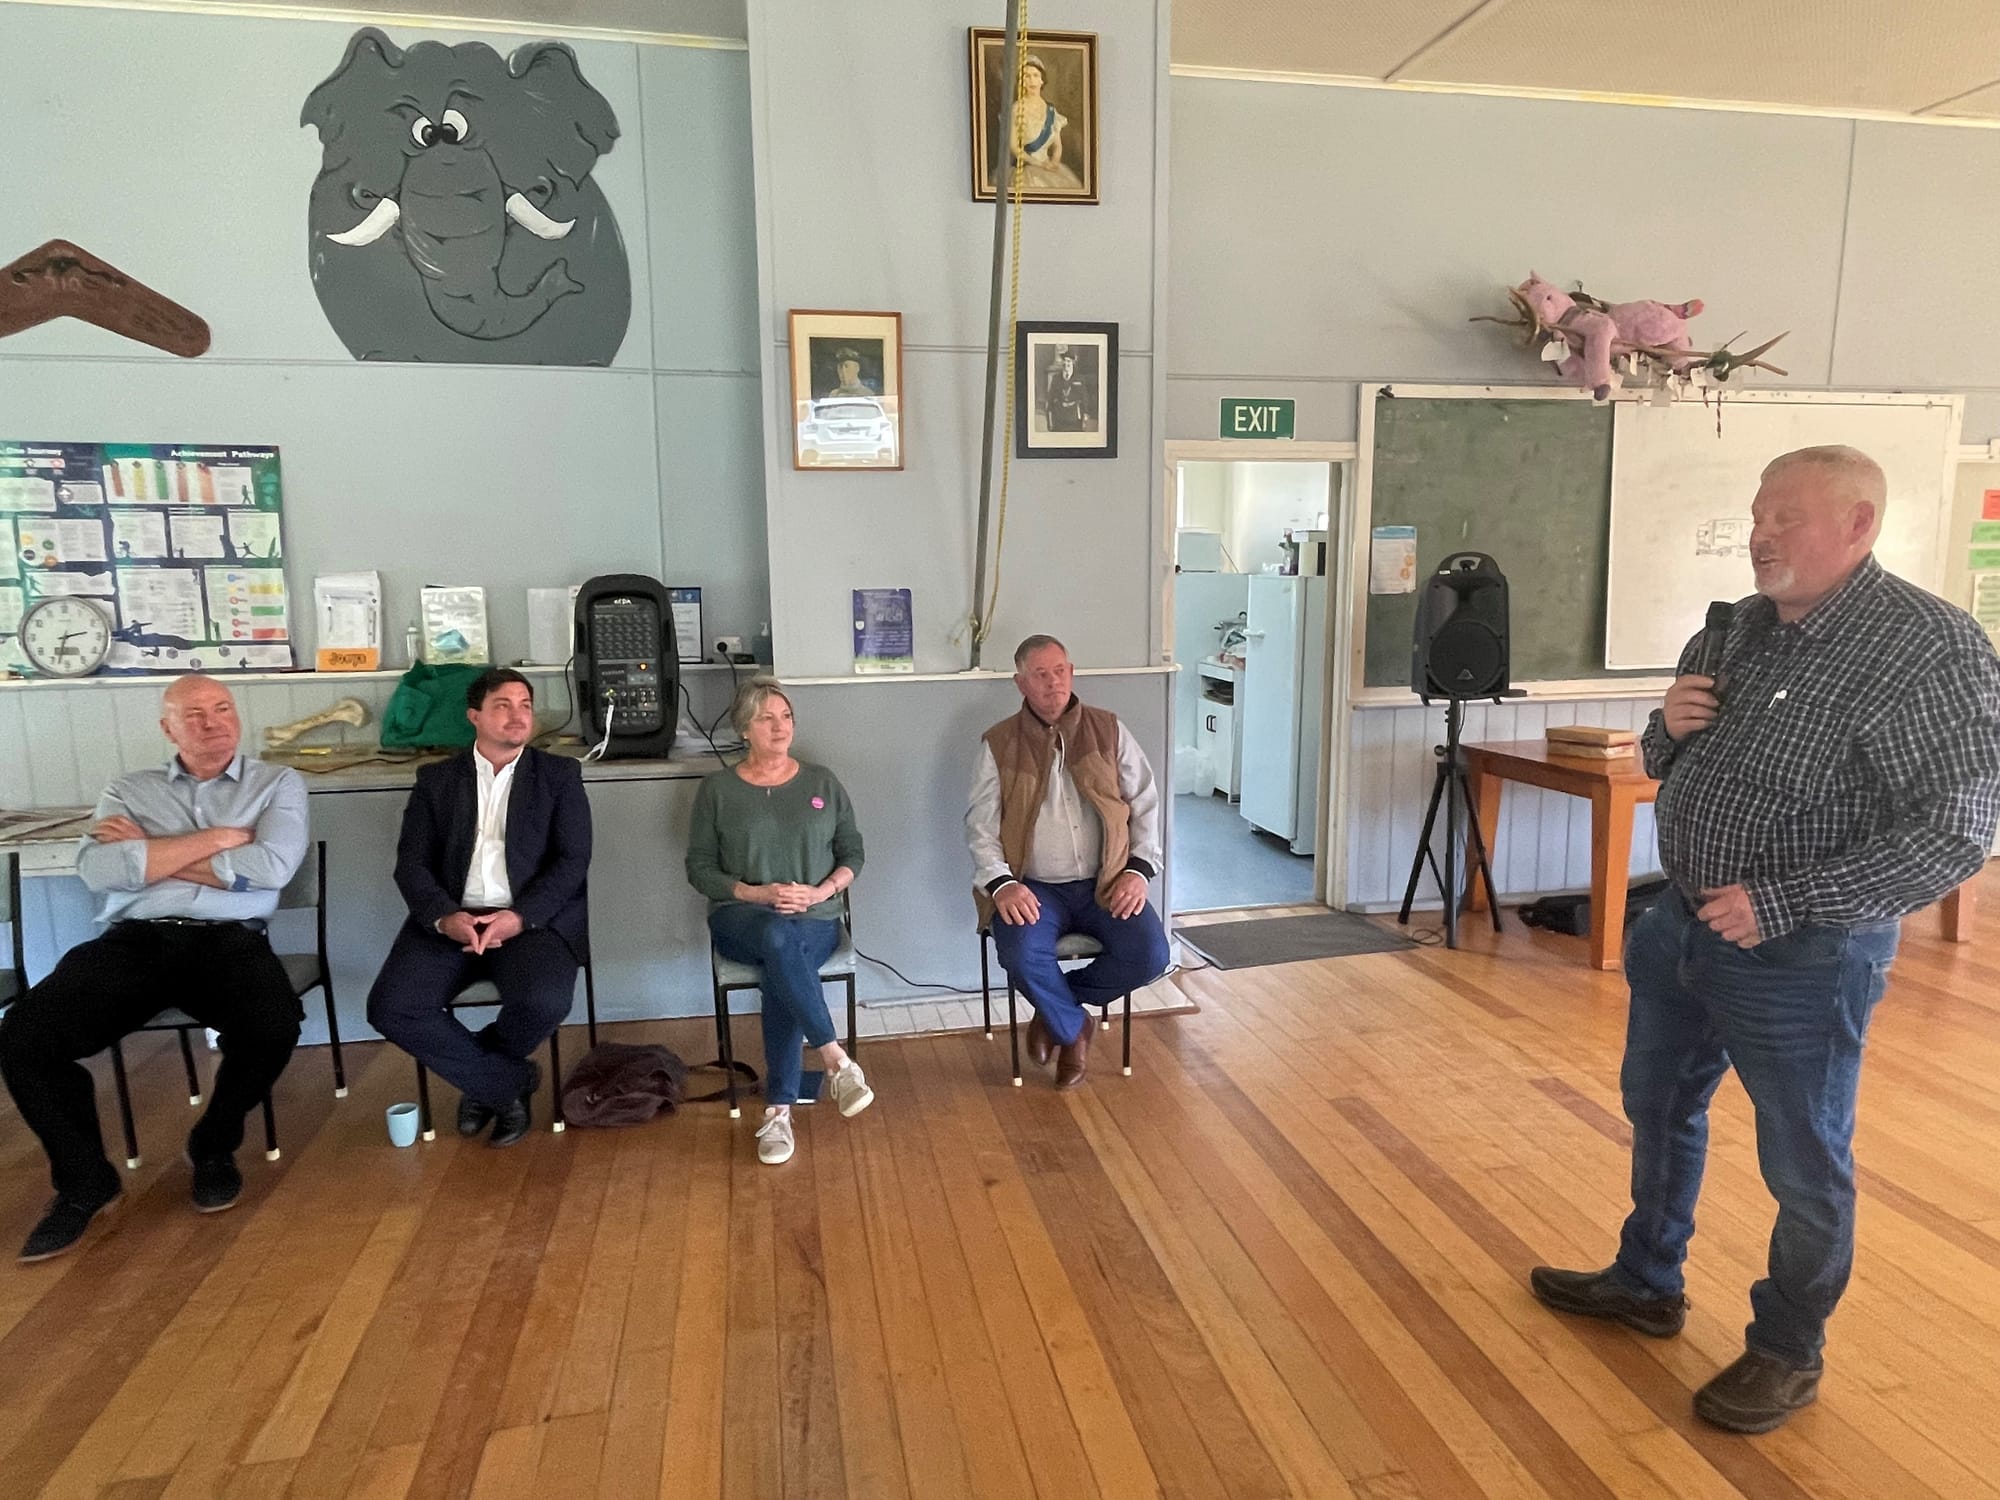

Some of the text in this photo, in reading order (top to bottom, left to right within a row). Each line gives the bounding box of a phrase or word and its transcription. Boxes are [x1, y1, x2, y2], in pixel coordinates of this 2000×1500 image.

[1234, 405, 1281, 432] EXIT
[170, 449, 275, 459] Achievement Pathways
